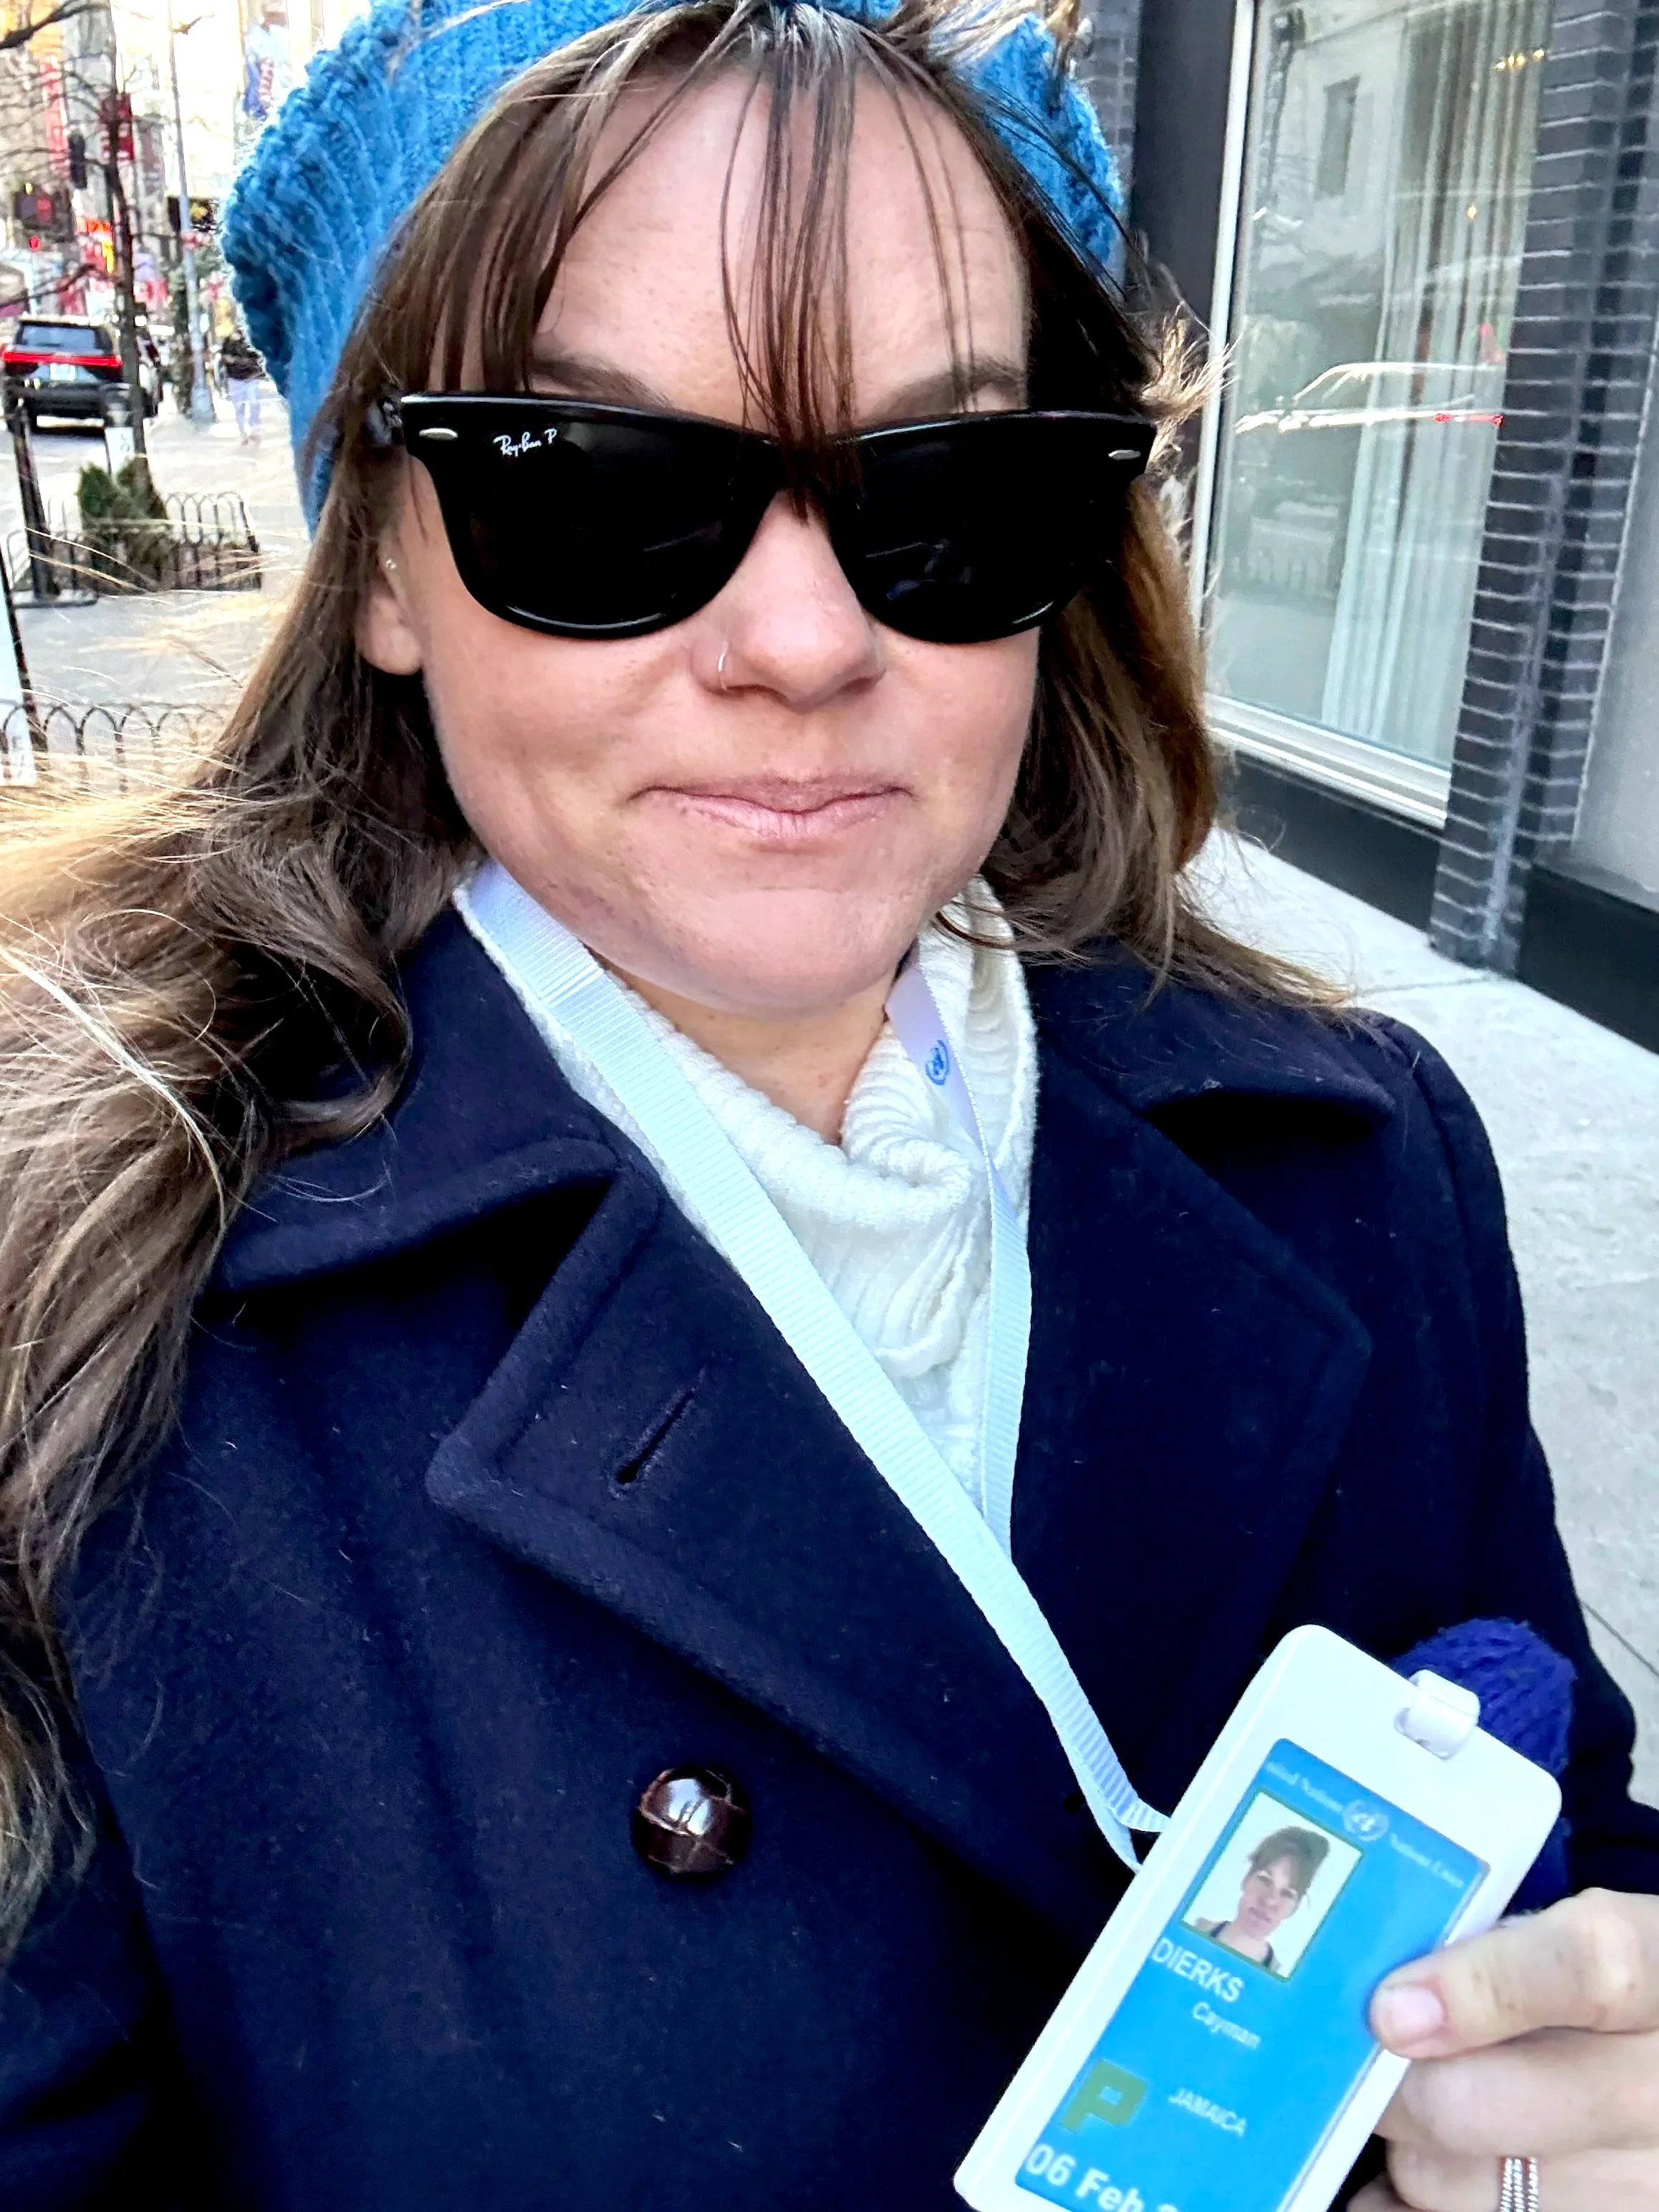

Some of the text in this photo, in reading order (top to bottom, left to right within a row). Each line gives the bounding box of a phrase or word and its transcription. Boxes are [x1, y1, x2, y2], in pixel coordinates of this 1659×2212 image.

[544, 428, 557, 444] P
[1150, 1936, 1245, 2003] DIERKS
[1191, 2001, 1261, 2050] Cayman
[1061, 2058, 1146, 2133] P
[1168, 2087, 1248, 2138] JAMAICA
[1024, 2143, 1146, 2212] 06 Feb
